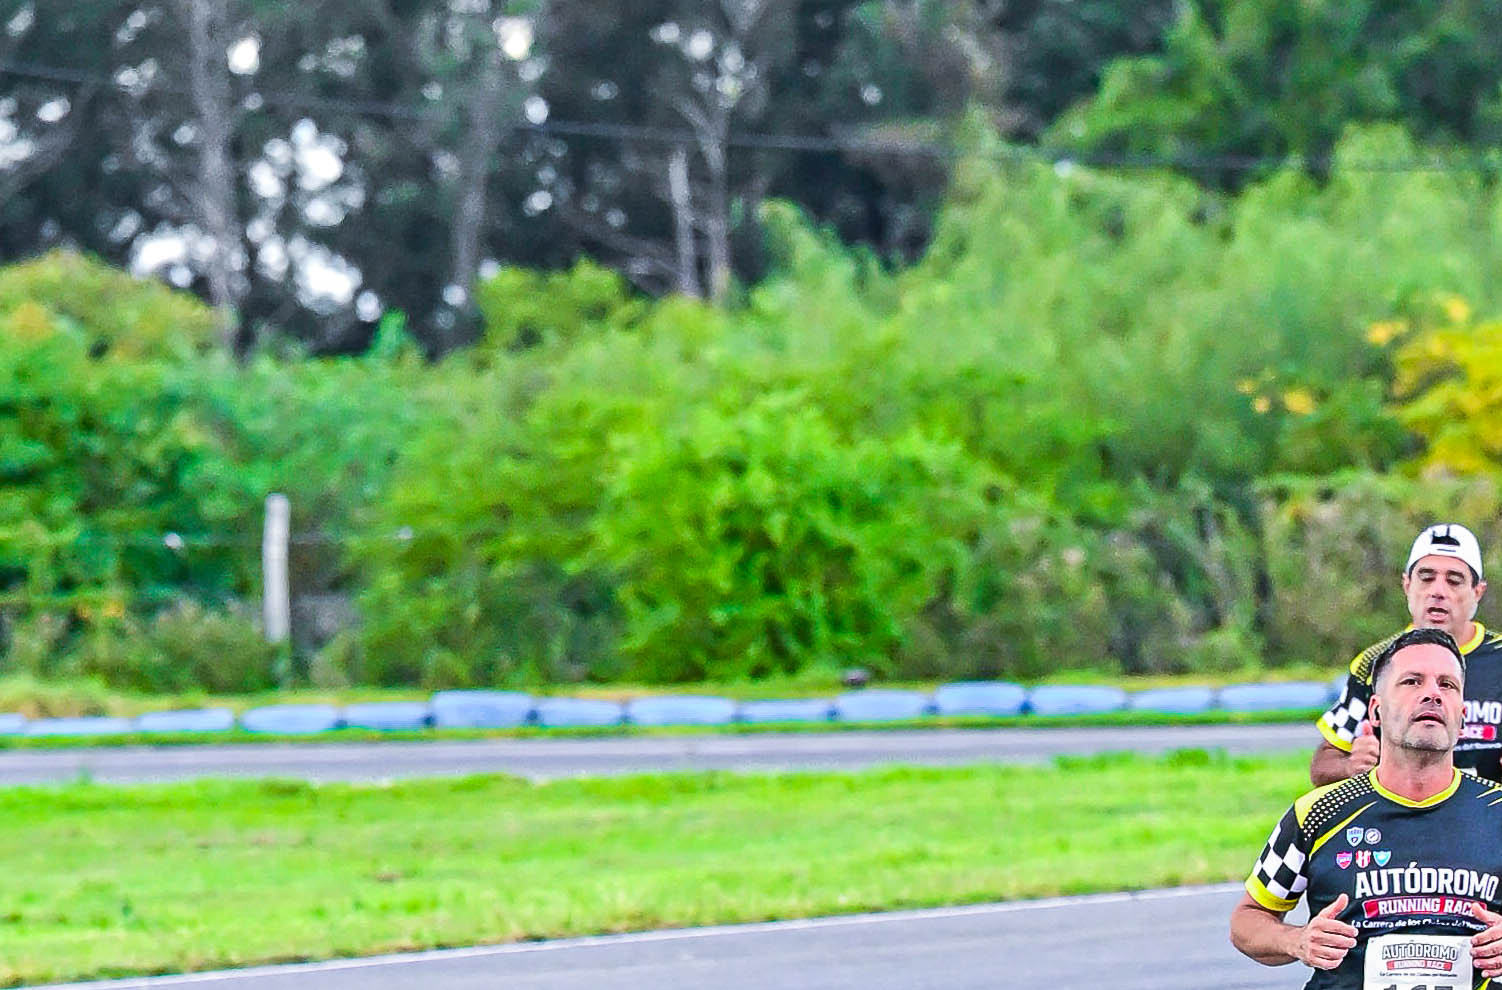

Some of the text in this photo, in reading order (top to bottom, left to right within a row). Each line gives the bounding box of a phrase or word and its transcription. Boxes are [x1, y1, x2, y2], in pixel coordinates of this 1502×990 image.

[1355, 861, 1499, 901] AUTÓDROMO
[1378, 898, 1441, 915] RUNNING
[1362, 919, 1394, 929] Carrera
[1395, 919, 1407, 927] de
[1382, 940, 1458, 961] AUTÓDROMO
